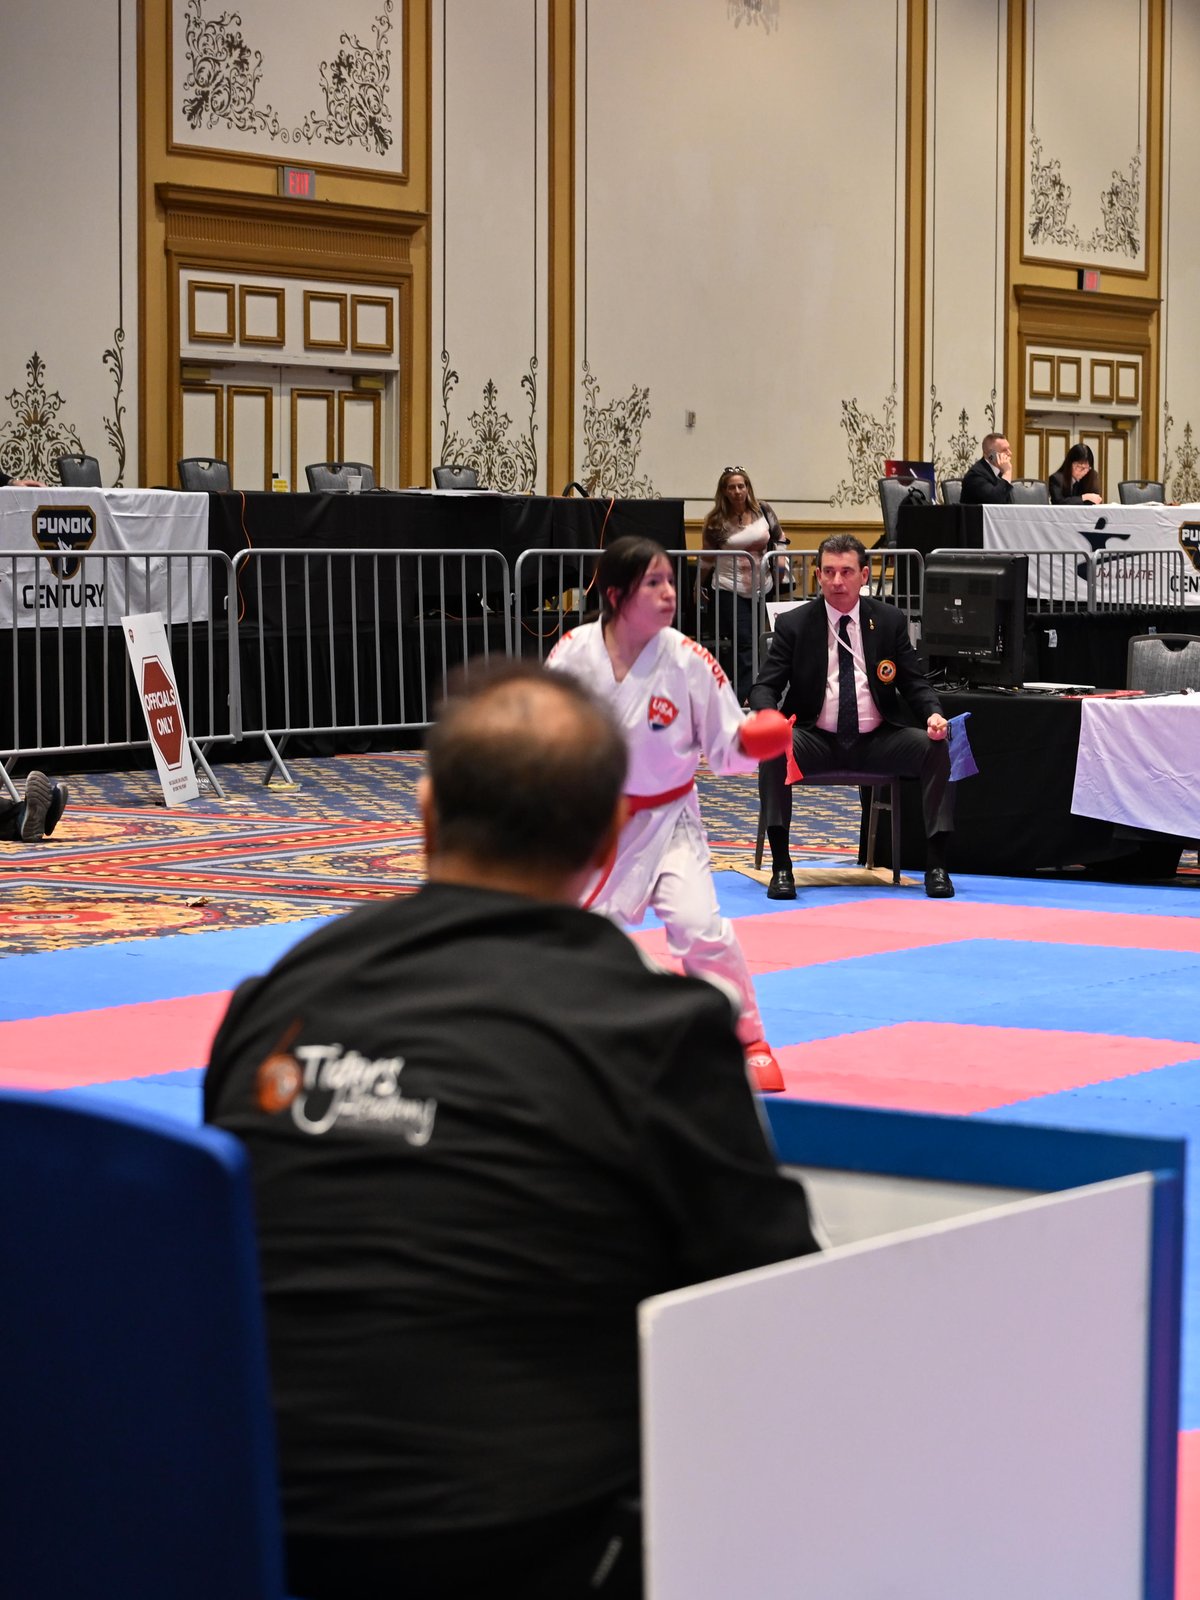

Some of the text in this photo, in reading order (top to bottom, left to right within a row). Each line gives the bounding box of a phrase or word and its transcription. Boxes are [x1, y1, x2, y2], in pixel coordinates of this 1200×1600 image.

[289, 171, 309, 195] EXIT
[36, 517, 93, 534] PUNOK
[22, 583, 104, 609] CENTURY
[681, 636, 727, 690] PUNOK
[144, 688, 176, 711] OFFICIALS
[652, 697, 675, 718] USA
[156, 716, 174, 736] ONLY
